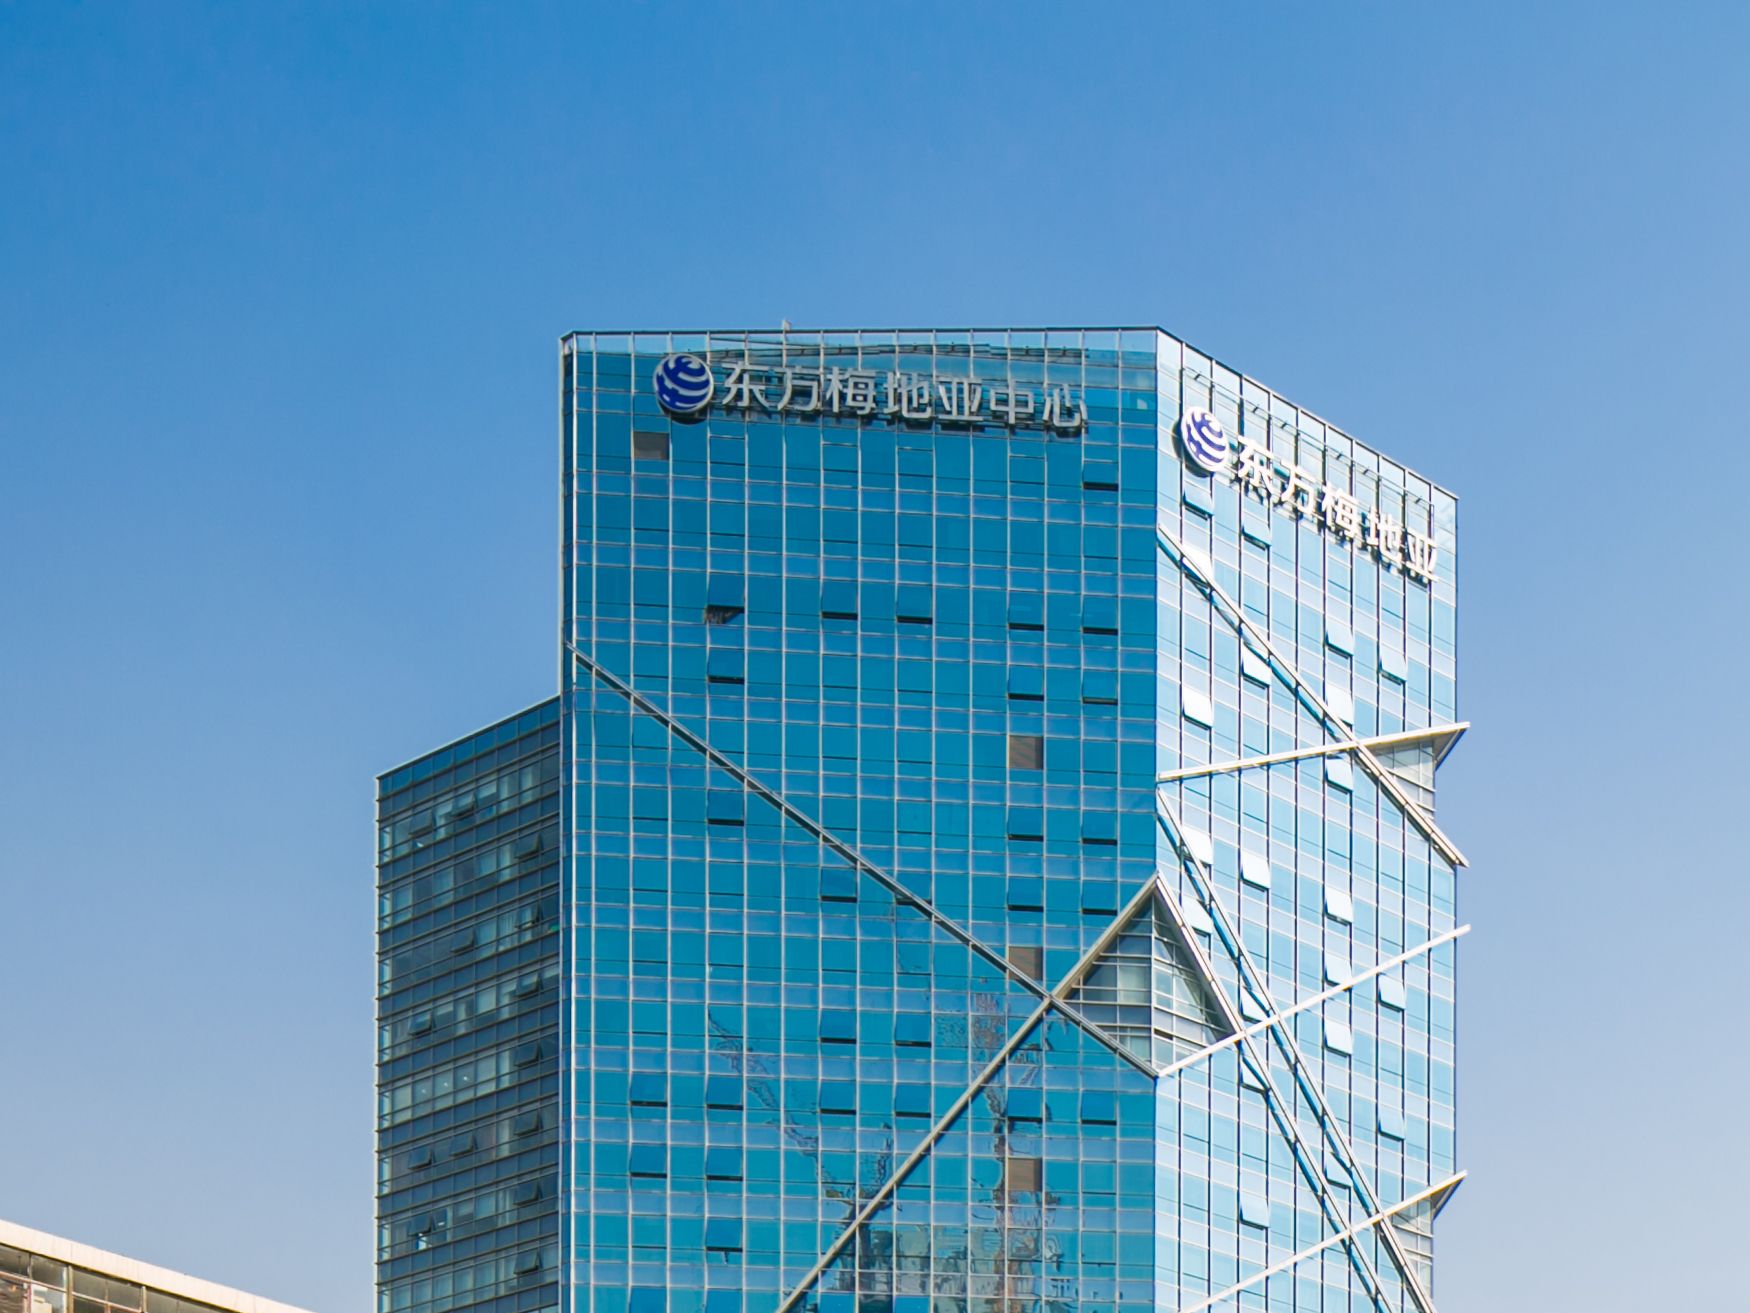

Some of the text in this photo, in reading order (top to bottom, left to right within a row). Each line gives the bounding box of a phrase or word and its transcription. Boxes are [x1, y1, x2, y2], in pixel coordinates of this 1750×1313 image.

[722, 362, 1088, 427] 东方梅地亚中心
[1238, 435, 1438, 583] 东方梅地亚
